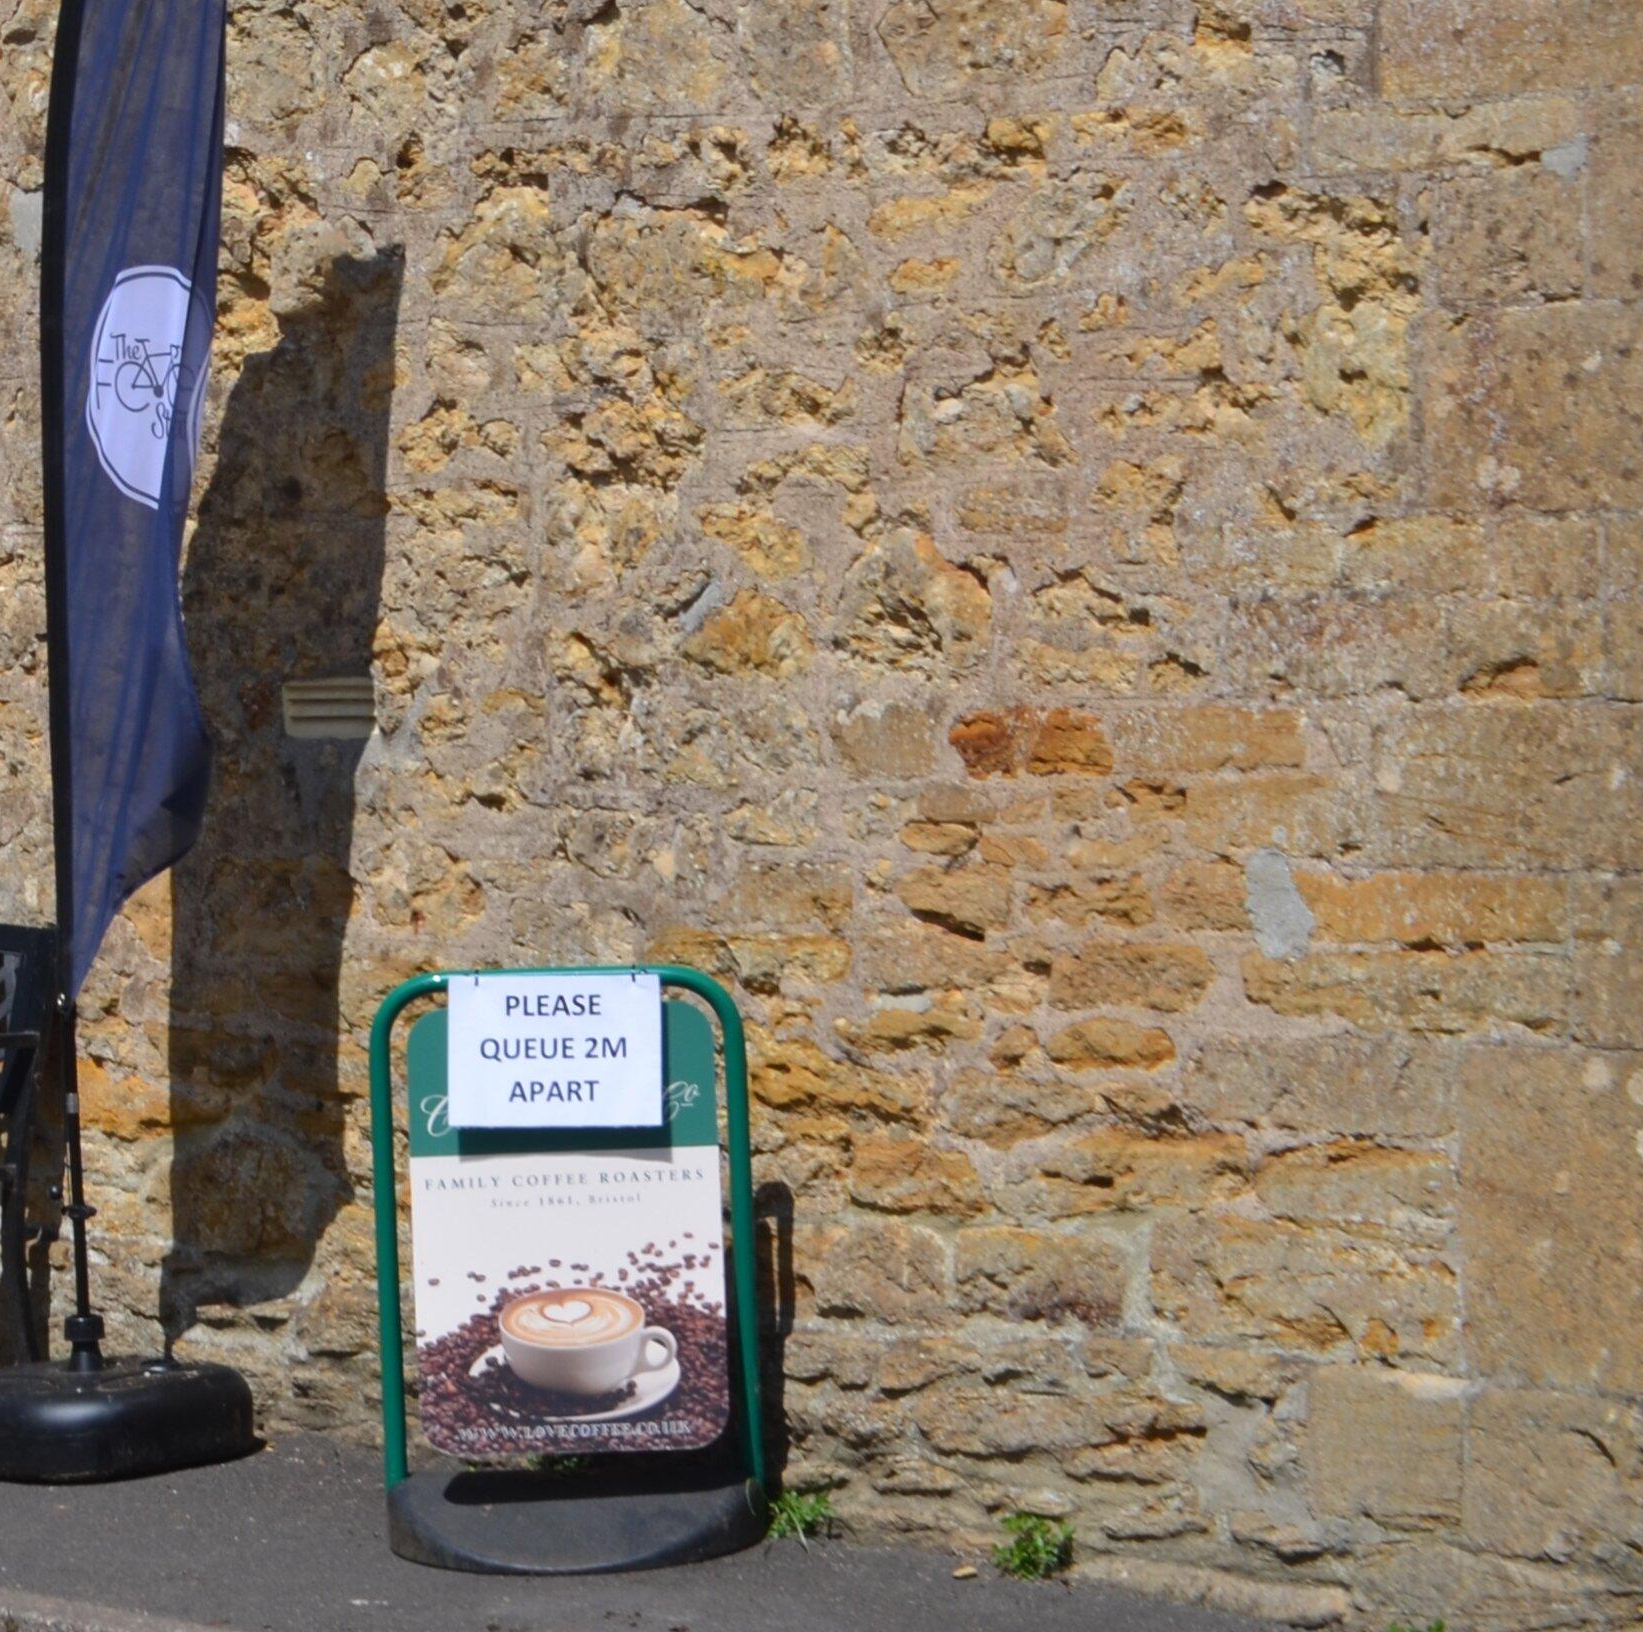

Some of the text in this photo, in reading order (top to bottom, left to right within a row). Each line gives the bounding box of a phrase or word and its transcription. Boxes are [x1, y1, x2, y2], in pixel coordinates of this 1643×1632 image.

[110, 332, 141, 362] The
[505, 994, 603, 1017] PLEASE
[479, 1036, 628, 1062] QUEUE 2M
[508, 1079, 600, 1103] APART
[424, 1168, 705, 1191] FAMILY COFFEE ROASTERS
